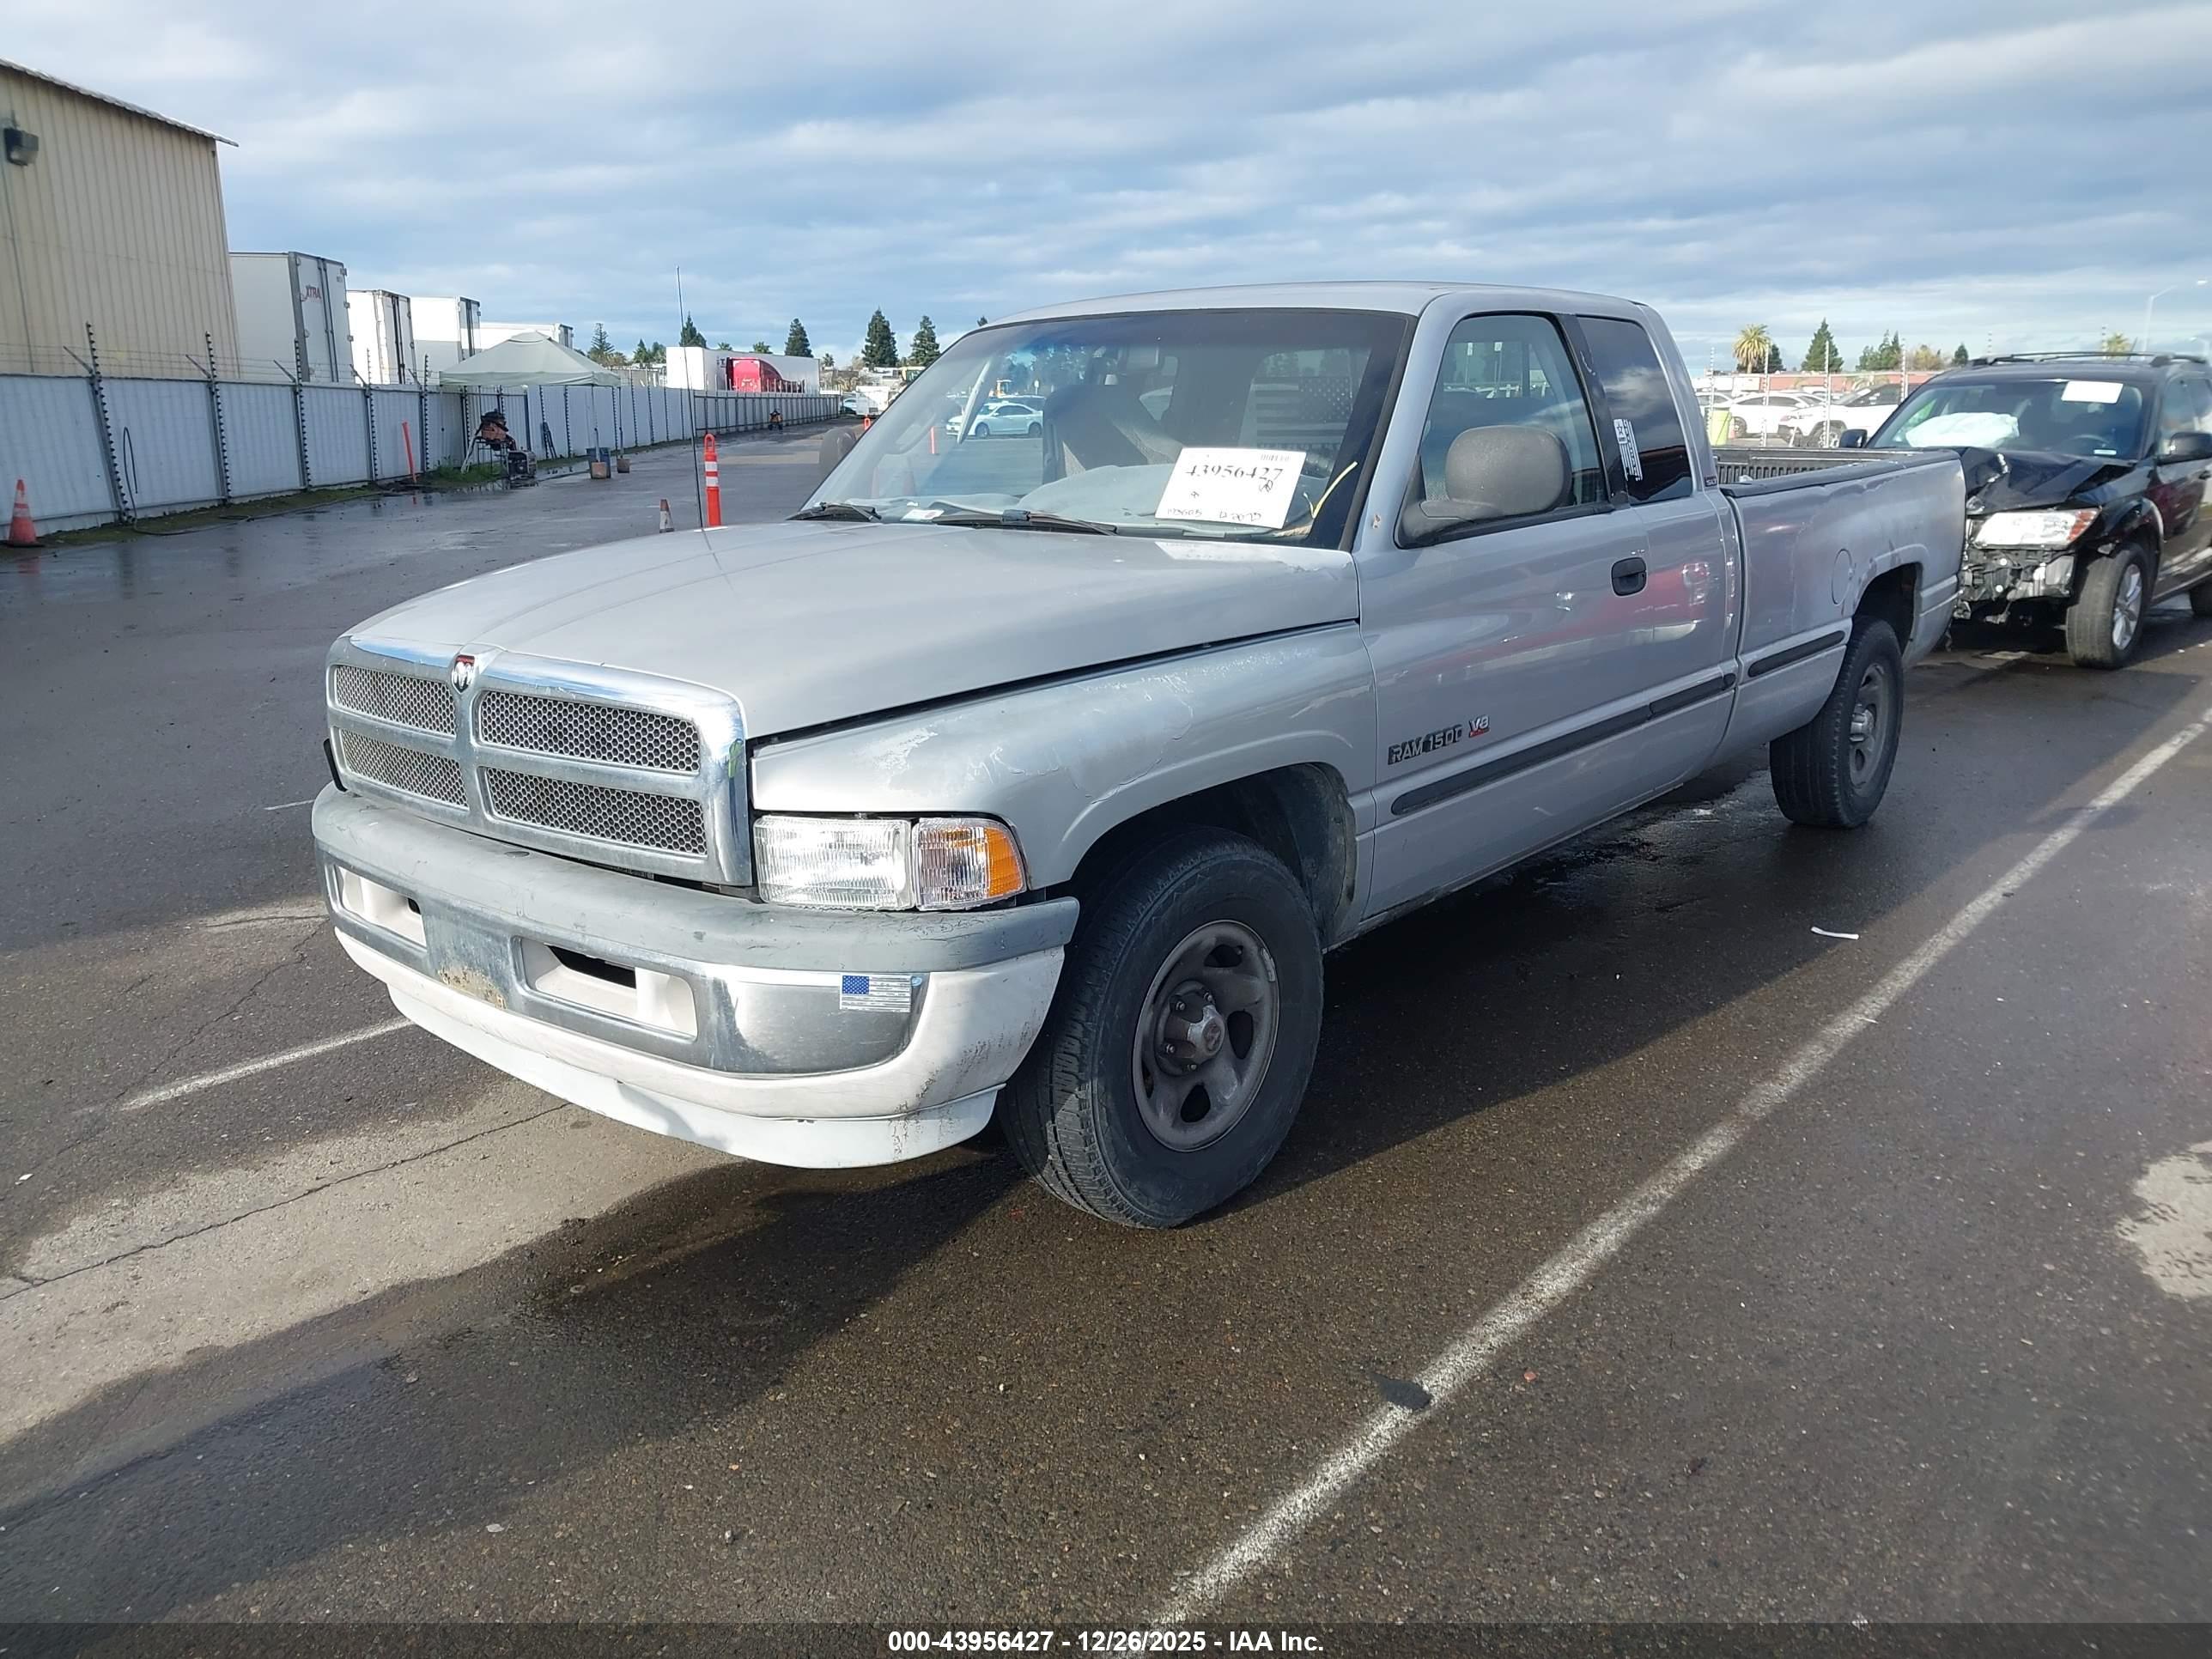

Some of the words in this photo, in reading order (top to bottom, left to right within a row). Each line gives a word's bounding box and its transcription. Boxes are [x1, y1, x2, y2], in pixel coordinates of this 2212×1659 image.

[1186, 465, 1284, 482] 43956427
[1389, 738, 1424, 764] RAM
[1427, 725, 1463, 752] 1500
[1469, 714, 1490, 732] V8
